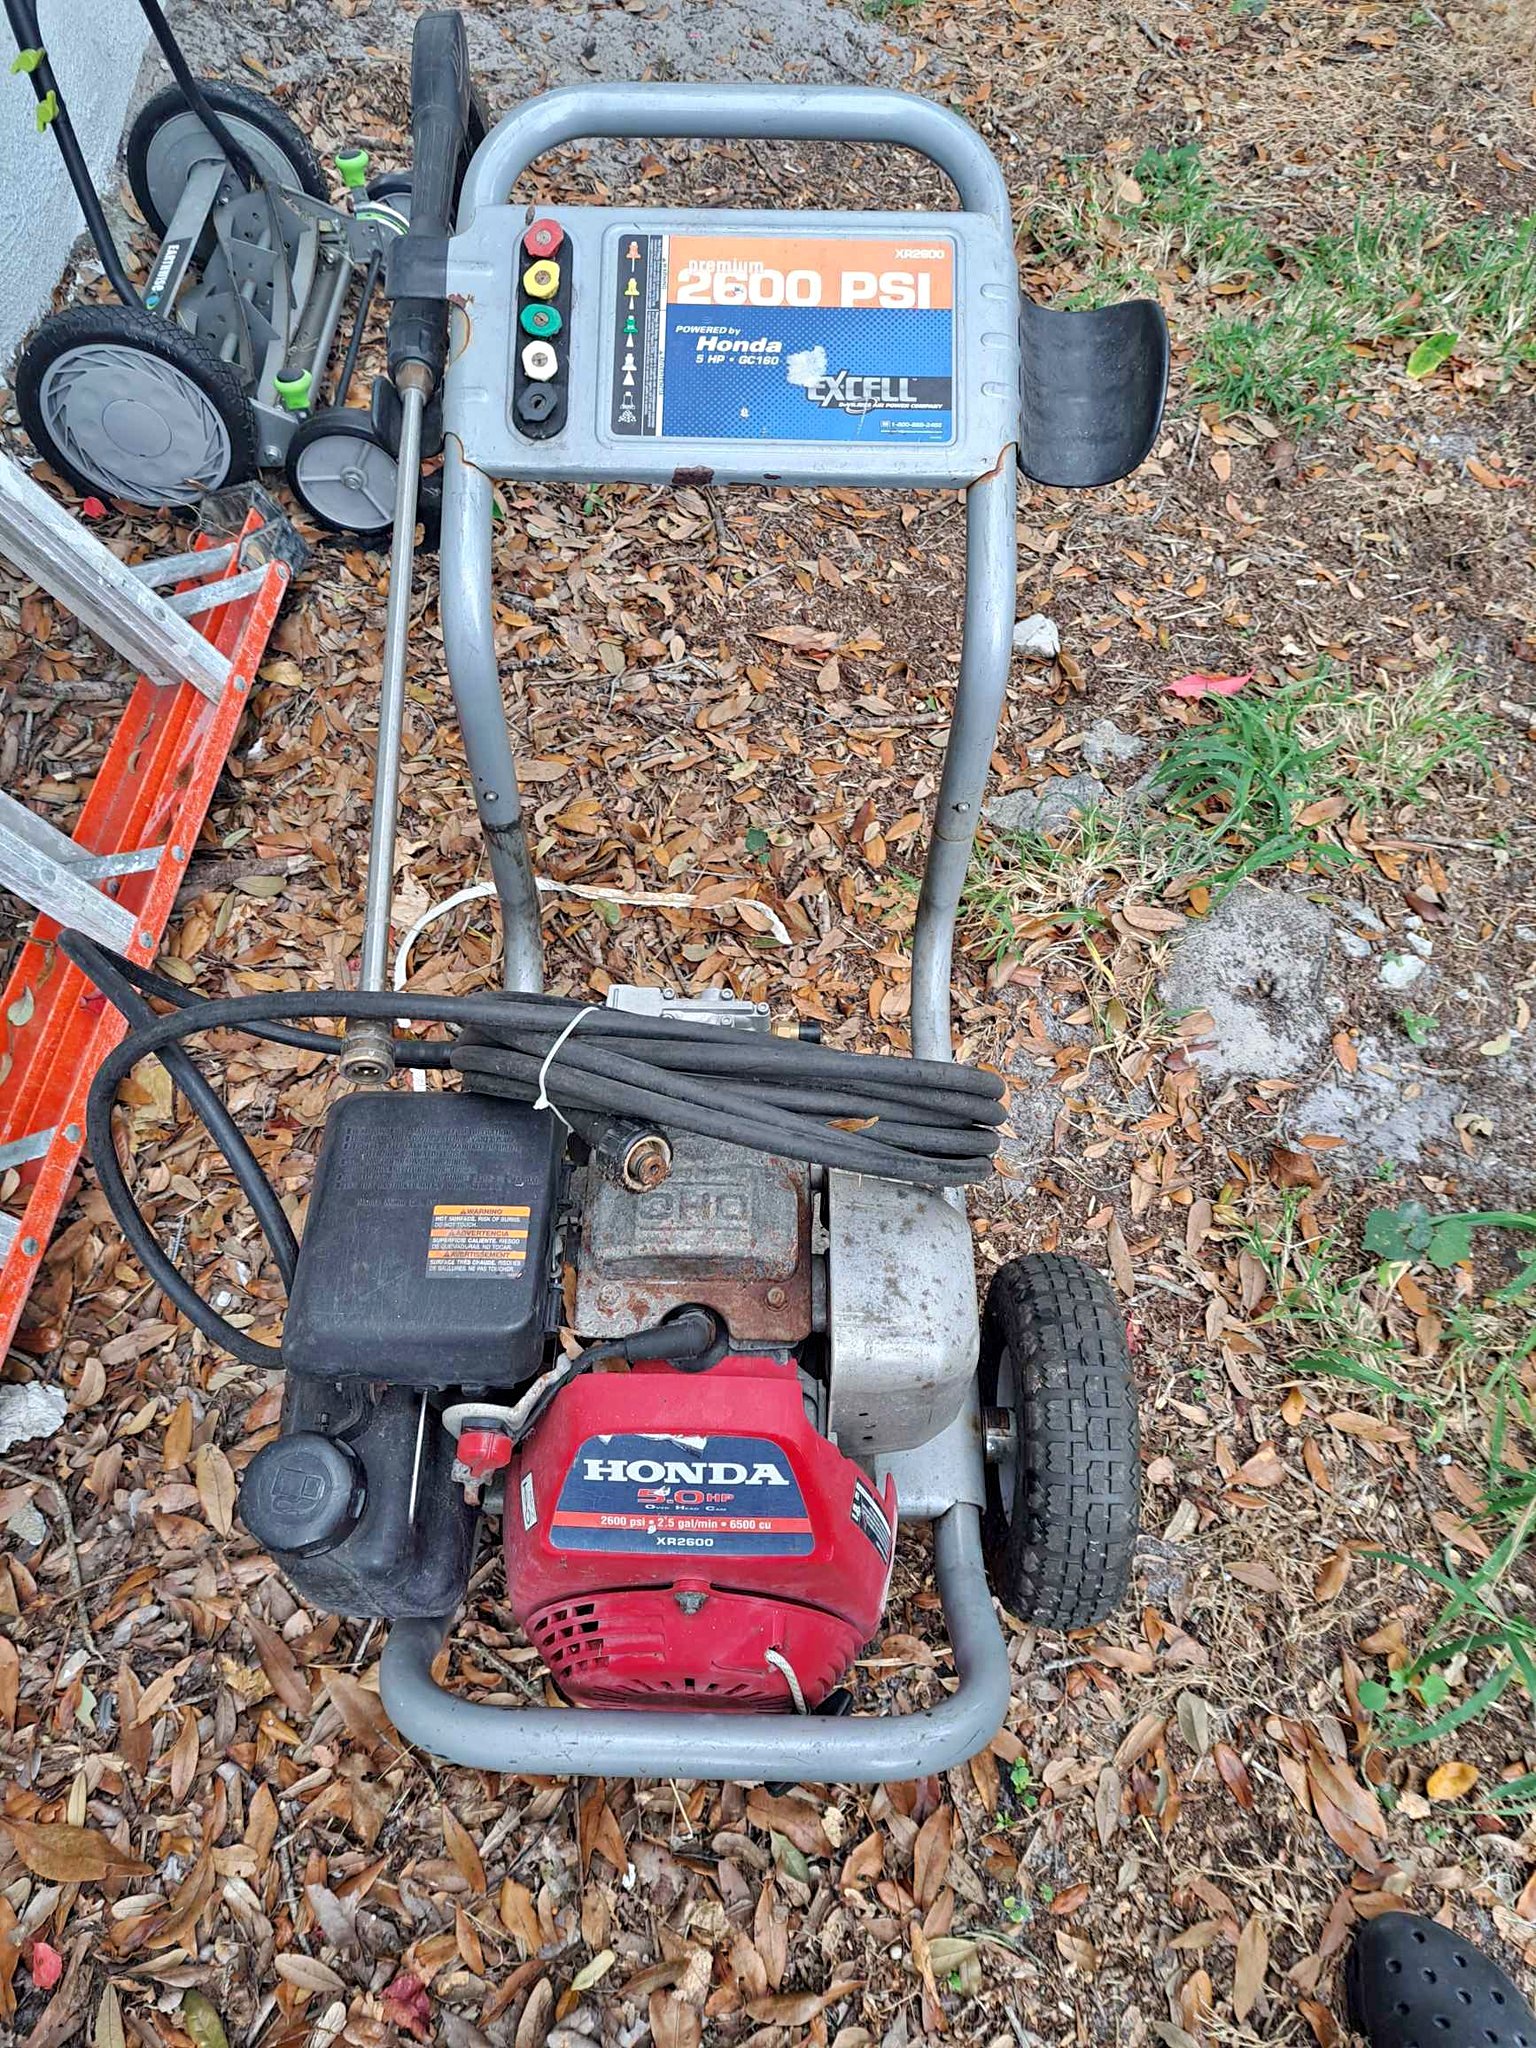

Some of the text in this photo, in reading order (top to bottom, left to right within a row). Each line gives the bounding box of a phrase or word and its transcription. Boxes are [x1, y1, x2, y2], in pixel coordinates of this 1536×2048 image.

[895, 249, 945, 259] XR2600
[688, 257, 763, 274] premium
[677, 267, 821, 306] 2600
[840, 271, 931, 309] PSI
[675, 325, 741, 336] POWERED by
[696, 336, 782, 353] Honda
[695, 354, 779, 365] 5 HP GC160
[807, 370, 917, 407] EXCELL
[584, 1459, 790, 1486] HONDA
[601, 1516, 771, 1530] 2600 psi 2.5 gal/min 6500 cu
[656, 1537, 714, 1546] XR2600
